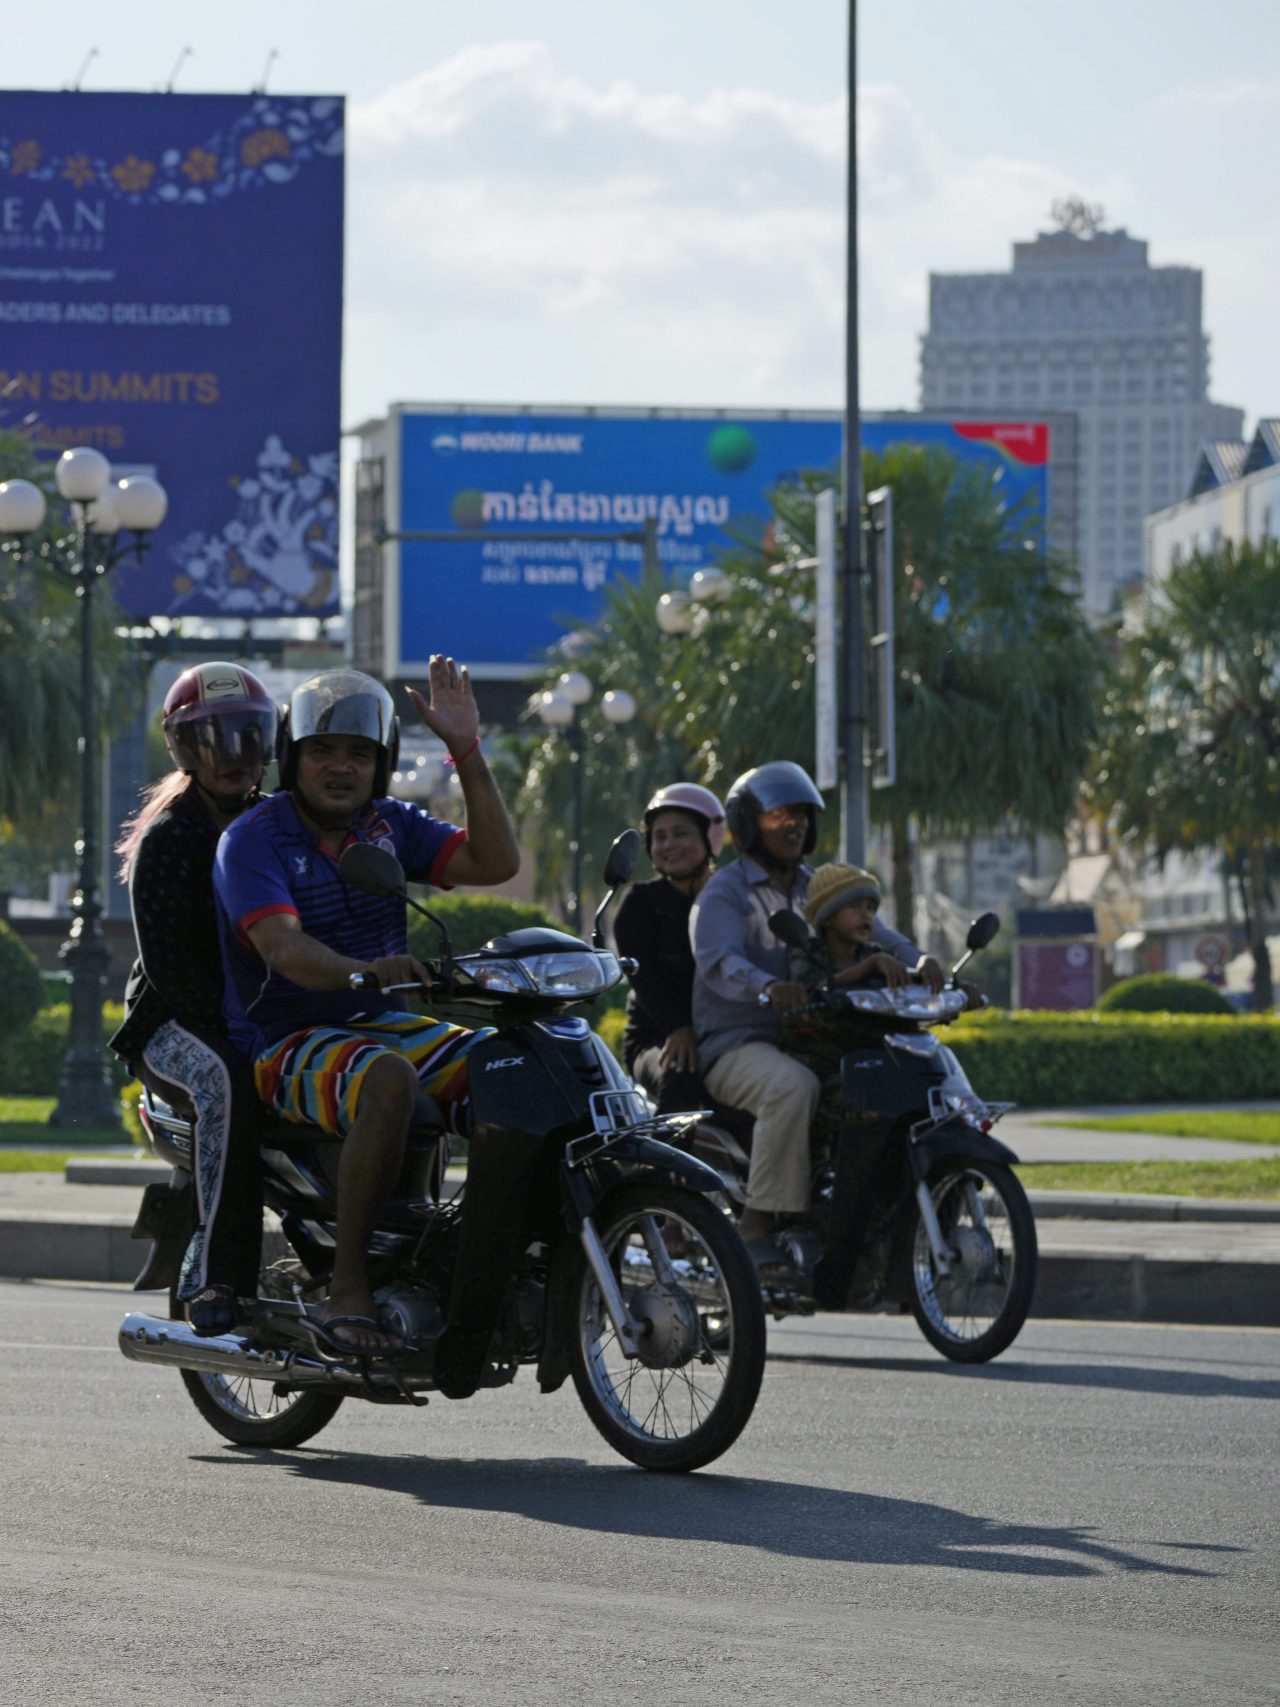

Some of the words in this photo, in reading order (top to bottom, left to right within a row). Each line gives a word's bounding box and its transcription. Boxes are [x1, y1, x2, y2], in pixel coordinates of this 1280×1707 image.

[65, 303, 111, 324] AND
[112, 304, 232, 326] DELEGATES
[49, 370, 219, 404] SUMMITS
[526, 433, 584, 455] BANK
[485, 1056, 526, 1071] NCX
